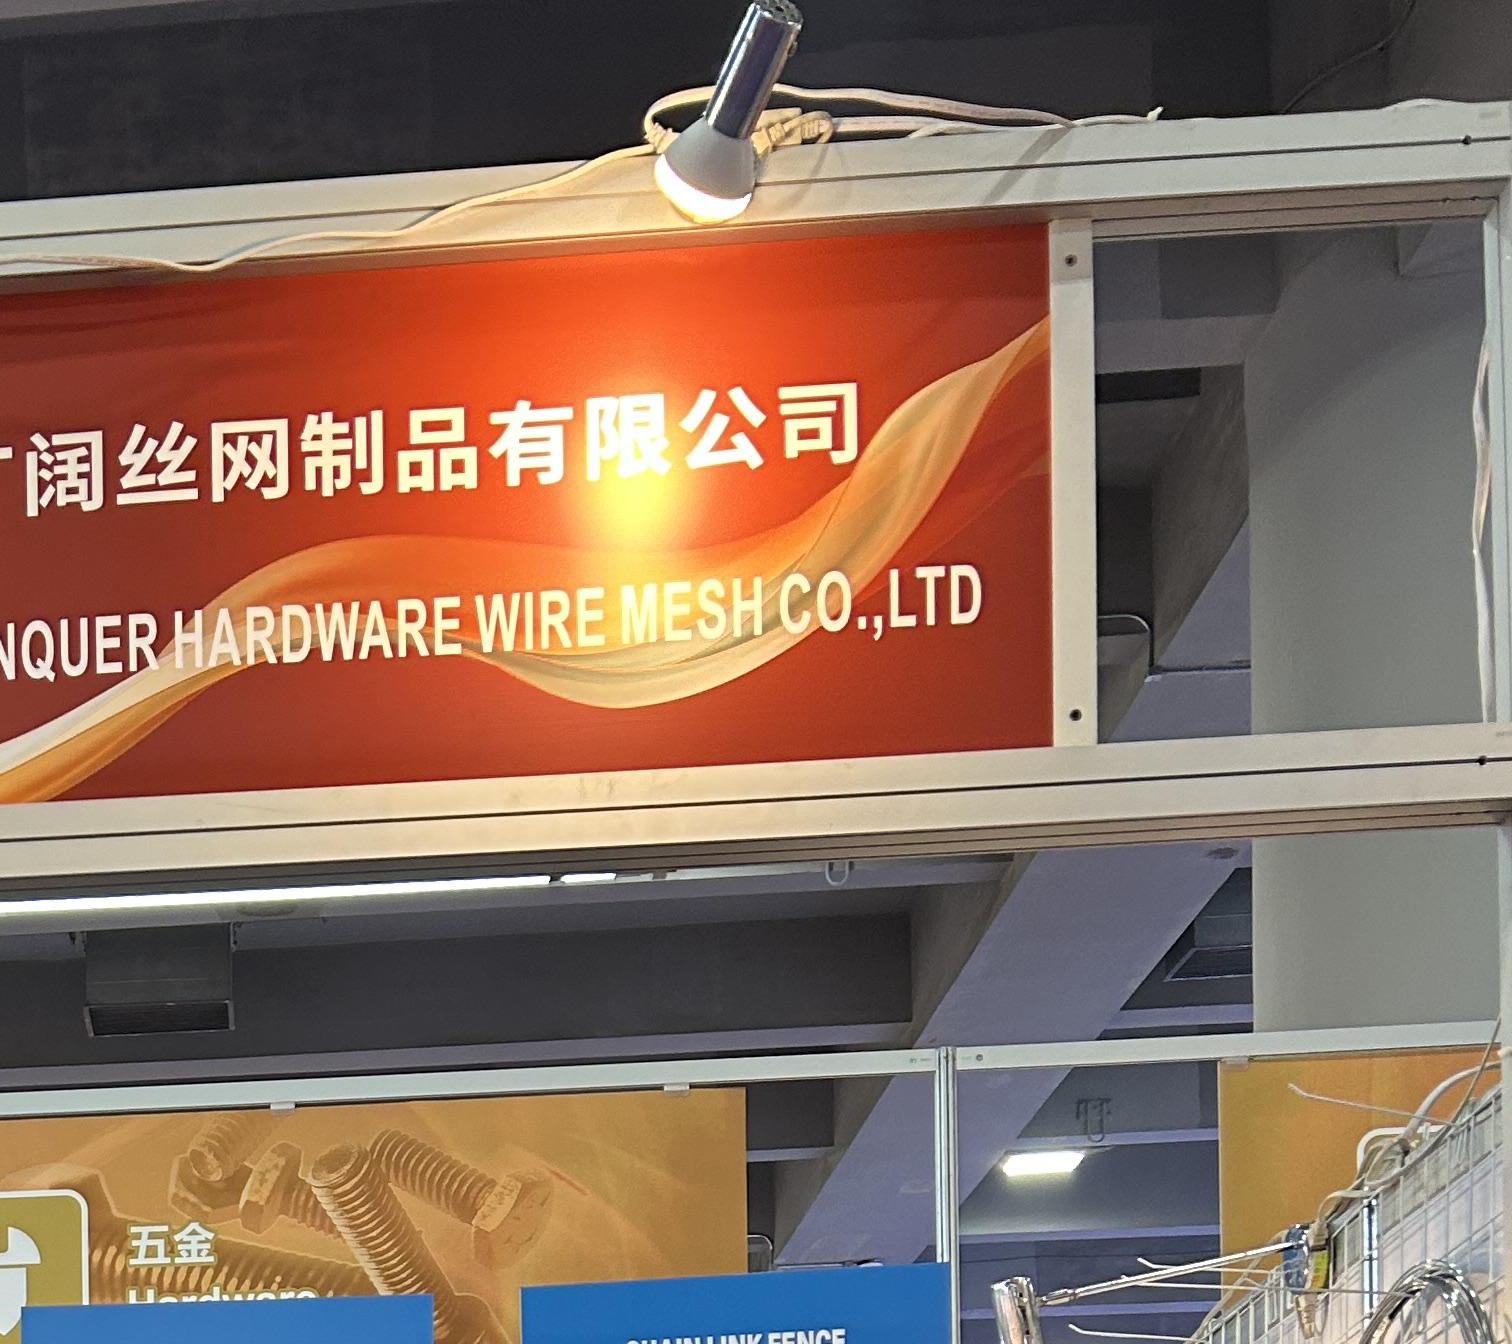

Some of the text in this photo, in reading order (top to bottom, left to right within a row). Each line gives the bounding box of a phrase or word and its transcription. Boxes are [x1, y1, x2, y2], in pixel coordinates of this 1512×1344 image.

[173, 595, 462, 669] HARDWARE
[475, 586, 606, 654] WIRE
[620, 576, 763, 645] MESH
[779, 564, 982, 642] CO.,LTD
[128, 1221, 215, 1266] 五金
